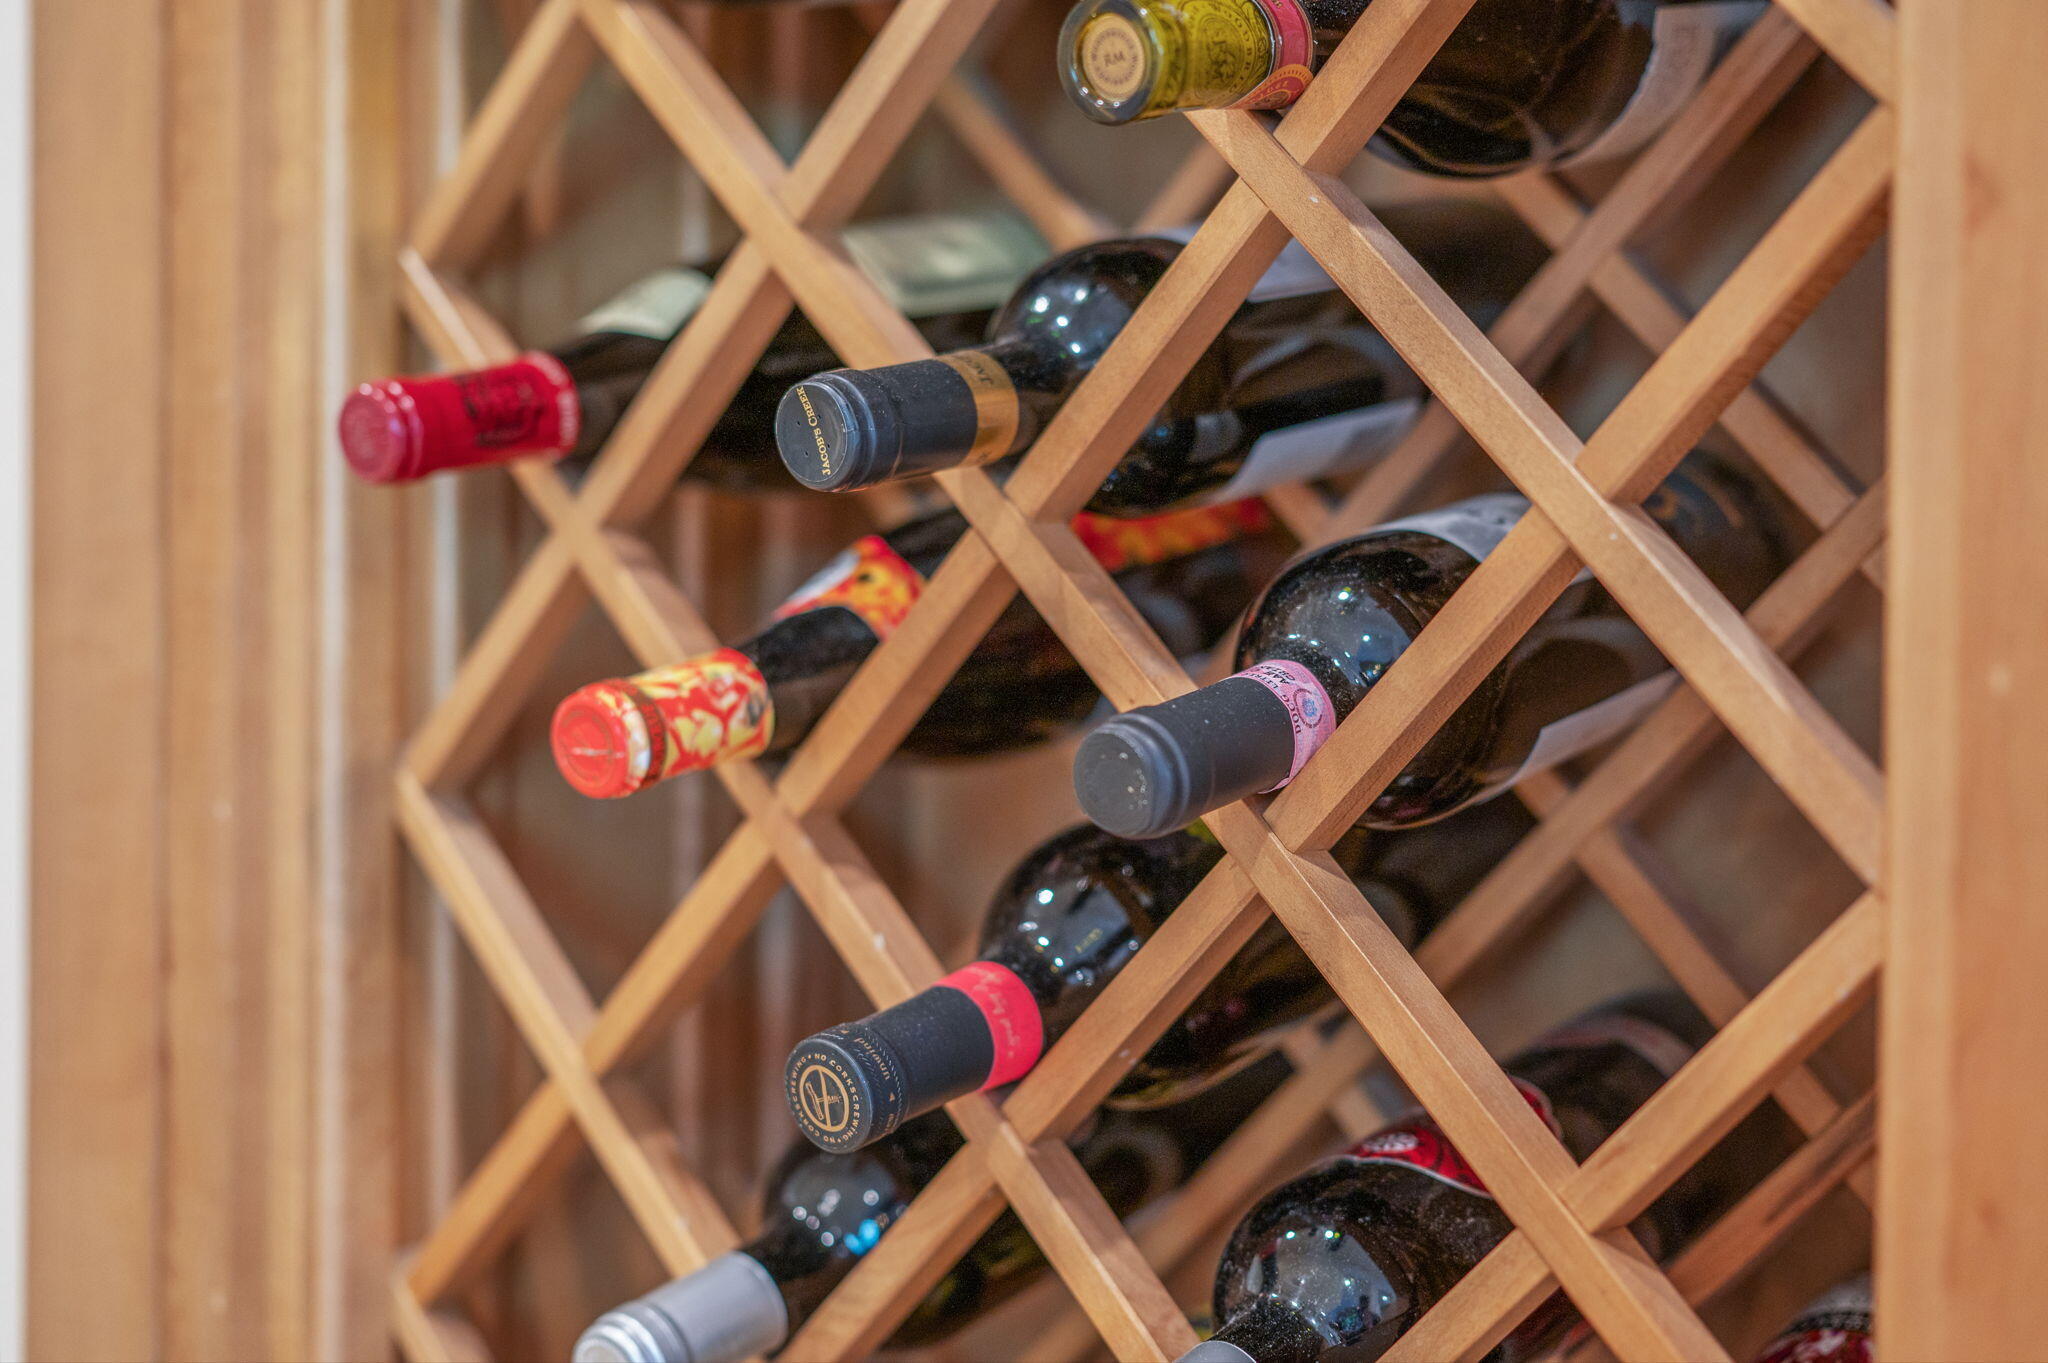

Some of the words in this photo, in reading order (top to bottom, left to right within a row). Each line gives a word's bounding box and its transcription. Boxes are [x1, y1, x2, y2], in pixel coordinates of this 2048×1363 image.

[796, 386, 818, 427] CREEK
[813, 428, 832, 476] JACOB'S
[1280, 694, 1302, 735] DOCG
[814, 1053, 828, 1062] NO
[854, 1037, 891, 1081] unwind
[829, 1060, 861, 1141] CORKSCREWING
[823, 1135, 837, 1144] NO
